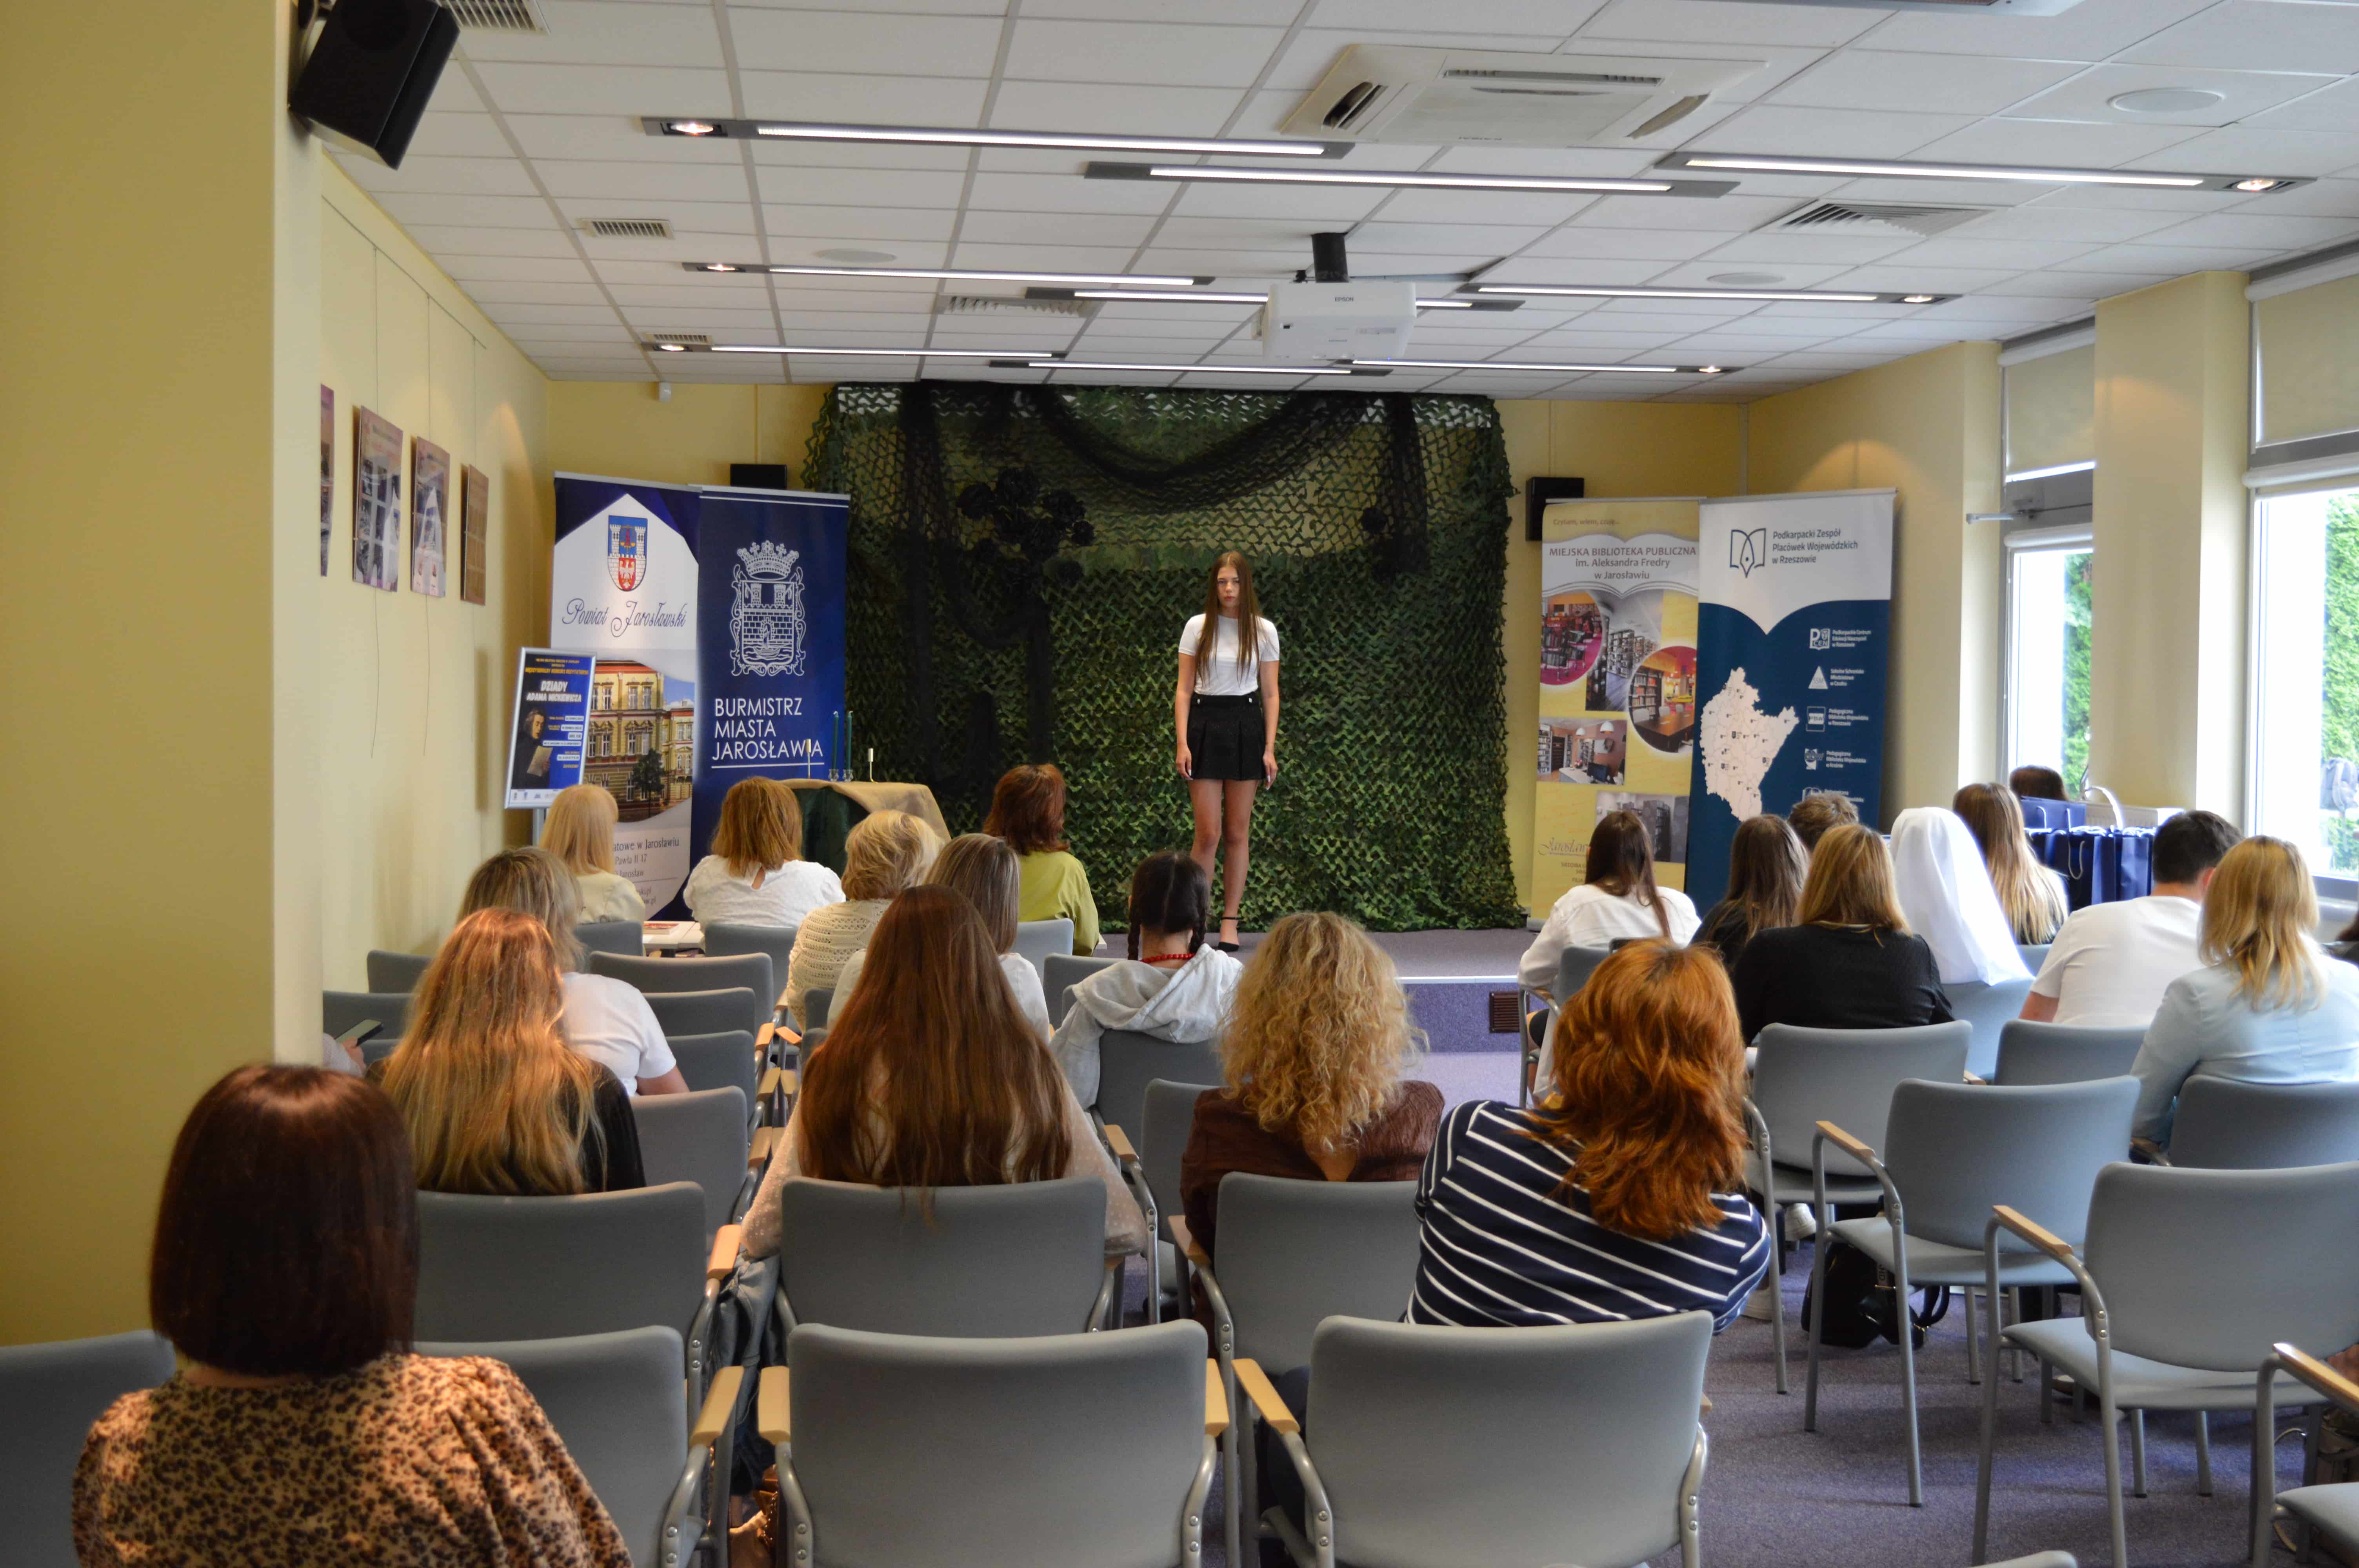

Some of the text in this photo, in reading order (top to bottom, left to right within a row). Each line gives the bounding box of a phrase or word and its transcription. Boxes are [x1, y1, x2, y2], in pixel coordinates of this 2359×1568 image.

[1773, 528, 1841, 540] Podkarpacki Zespół
[1549, 547, 1696, 556] MIEJSKA BIBLIOTEKA PUBLICZNA
[1772, 540, 1858, 552] Placówek Wojewódzkich
[1576, 558, 1670, 568] im. Aleksandra Fredry
[1779, 555, 1816, 564] Rzeszowie
[1604, 570, 1650, 579] Jarosławiu
[562, 598, 687, 637] Powiat Jarosławski
[540, 680, 568, 692] DZIADY
[527, 692, 547, 701] ADAMA
[715, 697, 802, 717] BURMISTRZ
[715, 719, 776, 739] MIASTA
[712, 739, 823, 760] JAROSŁAWA
[614, 842, 635, 851] atowe
[645, 837, 680, 850] Jarosławiu
